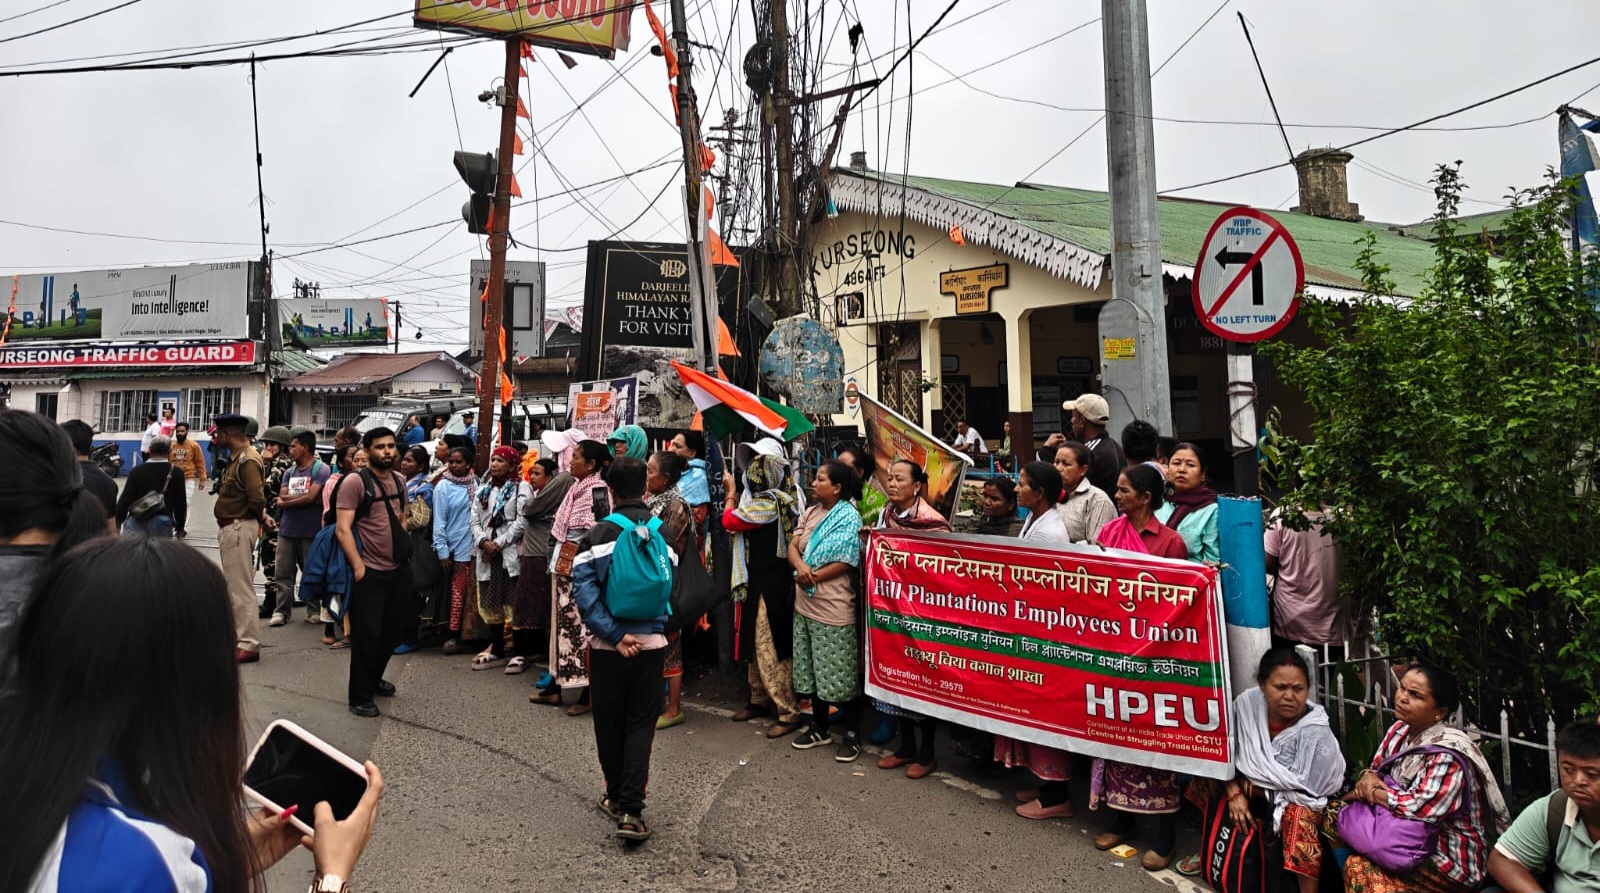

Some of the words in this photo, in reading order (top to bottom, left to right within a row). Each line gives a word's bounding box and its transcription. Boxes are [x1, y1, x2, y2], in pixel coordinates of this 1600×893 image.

[1233, 218, 1252, 226] WBP
[642, 282, 690, 292] DARJEELI
[617, 292, 678, 302] HIMALAYAN
[960, 291, 985, 301] KURSEONG
[132, 302, 148, 315] Into
[625, 305, 679, 320] THANK
[1231, 316, 1250, 324] LEFT
[619, 321, 649, 334] FOR
[654, 323, 692, 336] VISIT
[1200, 337, 1223, 348] 1881
[81, 347, 158, 362] TRAFFIC
[165, 346, 235, 361] GUARD
[876, 540, 910, 569] हिल
[1117, 572, 1198, 612] युनियन
[873, 578, 902, 600] Hill
[908, 584, 1008, 617] Plantations
[1014, 600, 1121, 635] Employees
[1129, 617, 1198, 644] Union
[874, 609, 891, 626] हिल
[981, 631, 1014, 650] युनियन
[1152, 658, 1199, 677] ইউনিয়ন
[938, 650, 966, 669] चिया
[1008, 667, 1044, 685] शाखा
[922, 675, 932, 684] No
[940, 680, 963, 692] 29579
[1086, 683, 1220, 732] HPEU
[1087, 720, 1119, 730] Constituent
[1156, 731, 1173, 739] Trade
[1195, 735, 1222, 746] CSTU
[1088, 728, 1114, 738] (Centre
[1127, 736, 1166, 749] Struggling
[1167, 742, 1190, 750] Trade
[1192, 745, 1222, 756] Unions)
[1212, 826, 1230, 882] SONY
